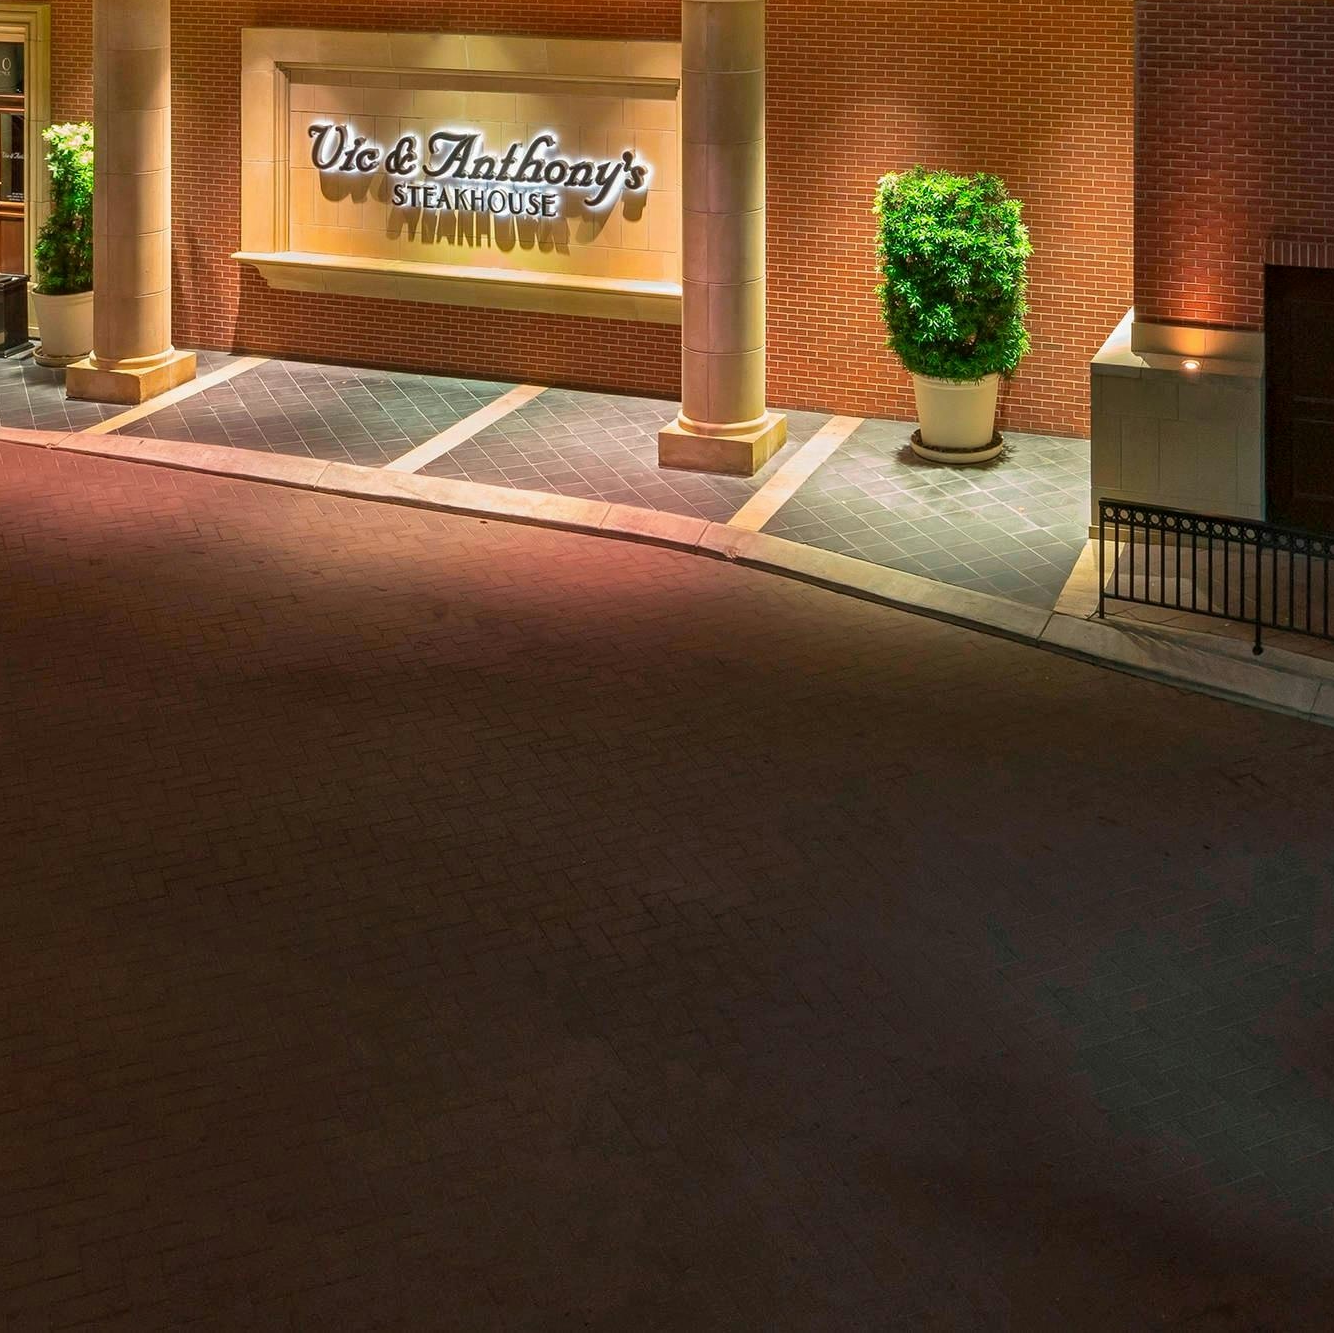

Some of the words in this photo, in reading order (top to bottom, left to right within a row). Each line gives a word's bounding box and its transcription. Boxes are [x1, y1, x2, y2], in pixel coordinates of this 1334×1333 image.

[308, 123, 380, 173] Vic
[385, 135, 418, 176] &
[422, 129, 649, 207] Anthony's
[391, 183, 559, 218] STEAKHOUSE
